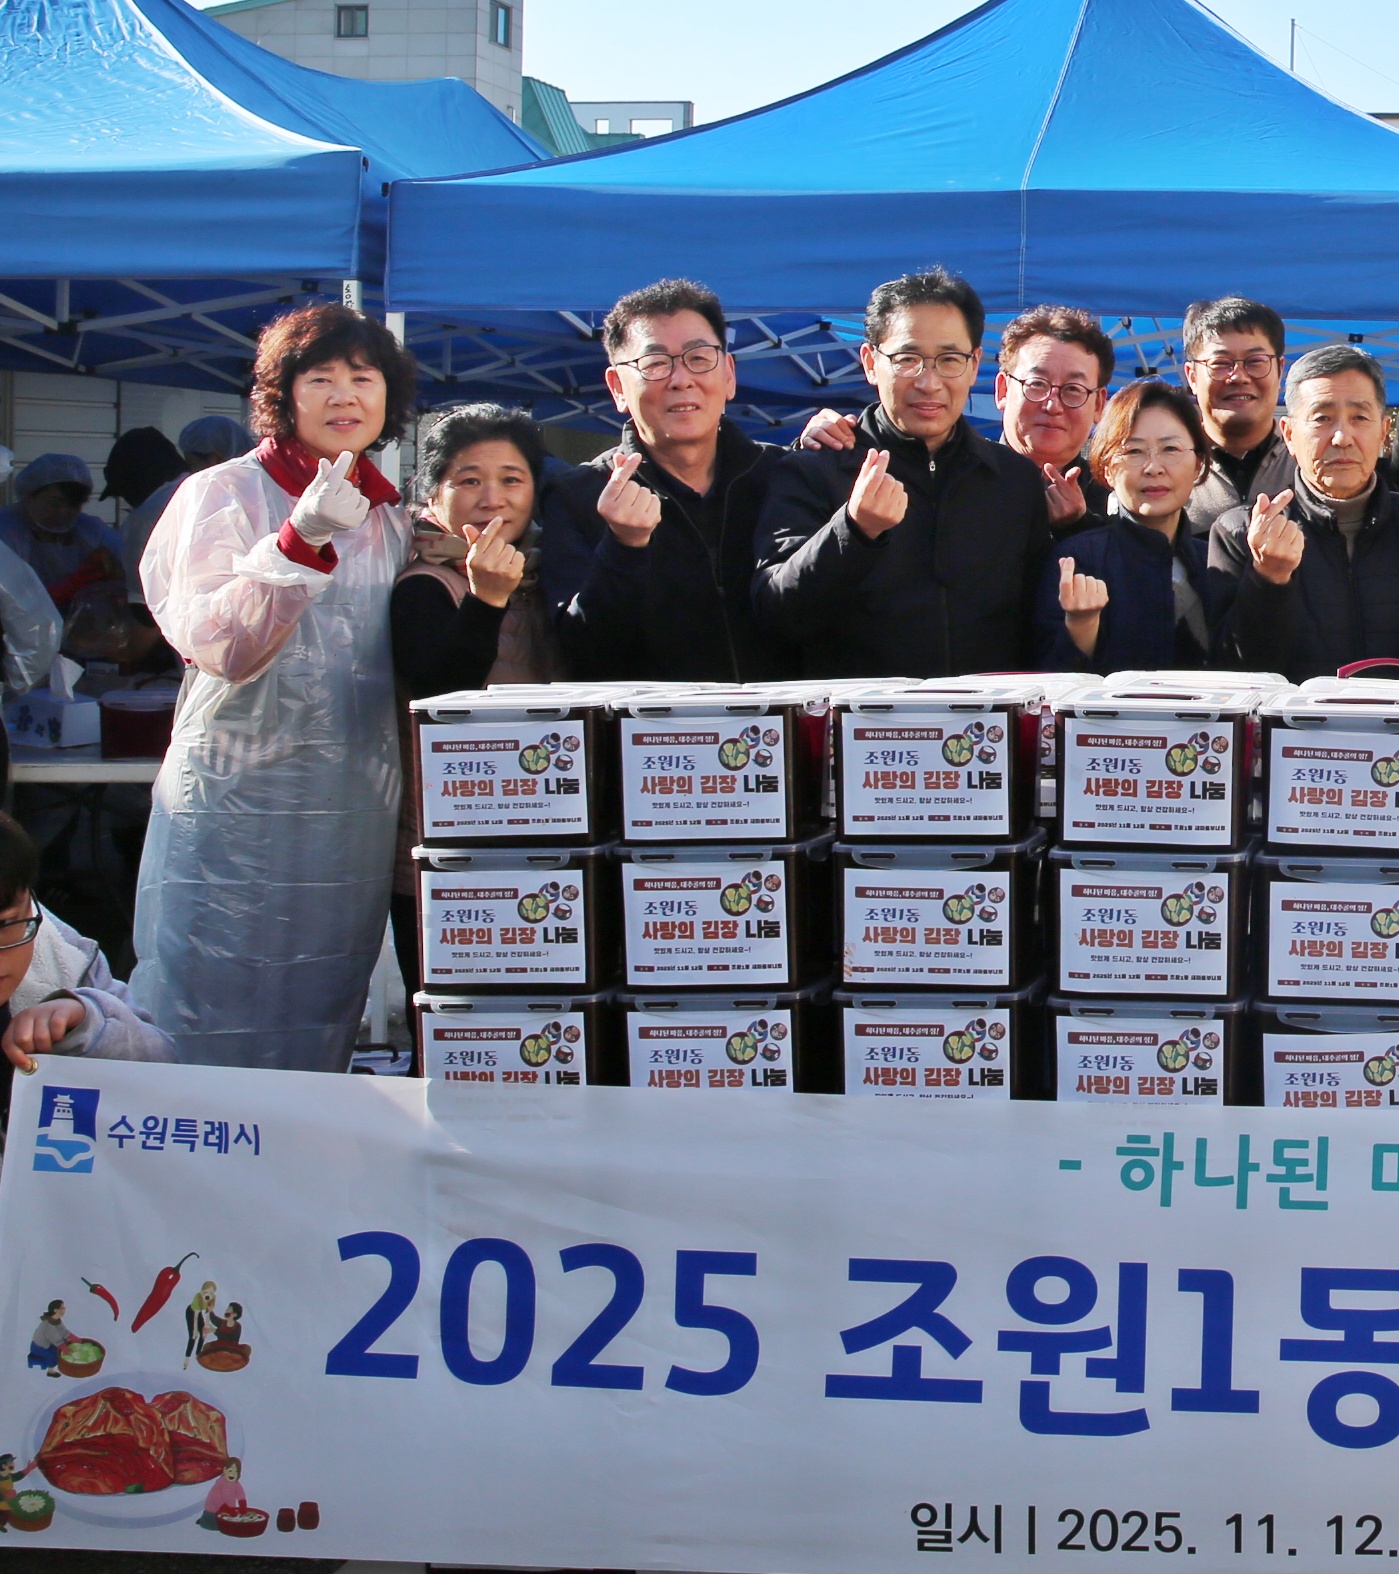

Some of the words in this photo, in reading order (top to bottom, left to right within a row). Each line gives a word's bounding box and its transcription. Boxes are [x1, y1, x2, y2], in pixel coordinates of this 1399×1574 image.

[641, 755, 697, 771] 조원1동
[864, 750, 920, 765] 조원1동
[1086, 756, 1143, 774] 조원1동
[442, 760, 497, 776] 조원1동
[1291, 767, 1348, 784] 조원1동
[441, 779, 494, 798] 사랑의
[501, 778, 538, 796] 김장
[544, 777, 579, 795] 나눔
[640, 775, 693, 795] 사랑의
[700, 775, 737, 794] 김장
[743, 774, 778, 793] 나눔
[863, 771, 916, 790] 사랑의
[924, 771, 960, 789] 김장
[967, 771, 1002, 789] 나눔
[1083, 777, 1138, 798] 사랑의
[1145, 779, 1183, 799] 김장
[1190, 781, 1226, 800] 나눔
[1288, 786, 1343, 806] 사랑의
[1350, 789, 1388, 808] 김장
[440, 908, 496, 923] 조원1동
[643, 900, 698, 916] 조원1동
[864, 907, 920, 922] 조원1동
[1081, 907, 1138, 924] 조원1동
[439, 927, 492, 945] 사랑의
[500, 927, 536, 944] 김장
[543, 926, 578, 944] 나눔
[642, 921, 695, 940] 사랑의
[702, 920, 739, 939] 김장
[745, 919, 780, 938] 나눔
[862, 926, 916, 944] 사랑의
[924, 927, 961, 945] 김장
[967, 928, 1003, 946] 나눔
[1291, 920, 1348, 936] 조원1동
[1079, 928, 1134, 948] 사랑의
[1141, 929, 1179, 949] 김장
[1185, 931, 1222, 950] 나눔
[1289, 939, 1343, 958] 사랑의
[1351, 941, 1388, 959] 김장
[443, 1050, 498, 1066] 조원1동
[649, 1048, 704, 1064] 조원1동
[864, 1046, 921, 1062] 조원1동
[1077, 1054, 1134, 1070] 조원1동
[647, 1069, 700, 1088] 사랑의
[708, 1069, 745, 1087] 김장
[751, 1068, 786, 1087] 나눔
[863, 1067, 917, 1086] 사랑의
[924, 1067, 961, 1086] 김장
[968, 1068, 1004, 1086] 나눔
[1075, 1075, 1130, 1095] 사랑의
[1137, 1076, 1175, 1095] 김장
[1182, 1077, 1218, 1096] 나눔
[1284, 1071, 1341, 1086] 조원1동
[1283, 1090, 1337, 1108] 사랑의
[1345, 1089, 1382, 1107] 김장
[107, 1115, 261, 1156] 수원특례시
[1116, 1133, 1330, 1212] 하나된
[325, 1230, 761, 1396] 2025
[910, 1503, 1003, 1555] 일시
[1057, 1509, 1198, 1556] 2025.
[1225, 1514, 1298, 1557] 11.
